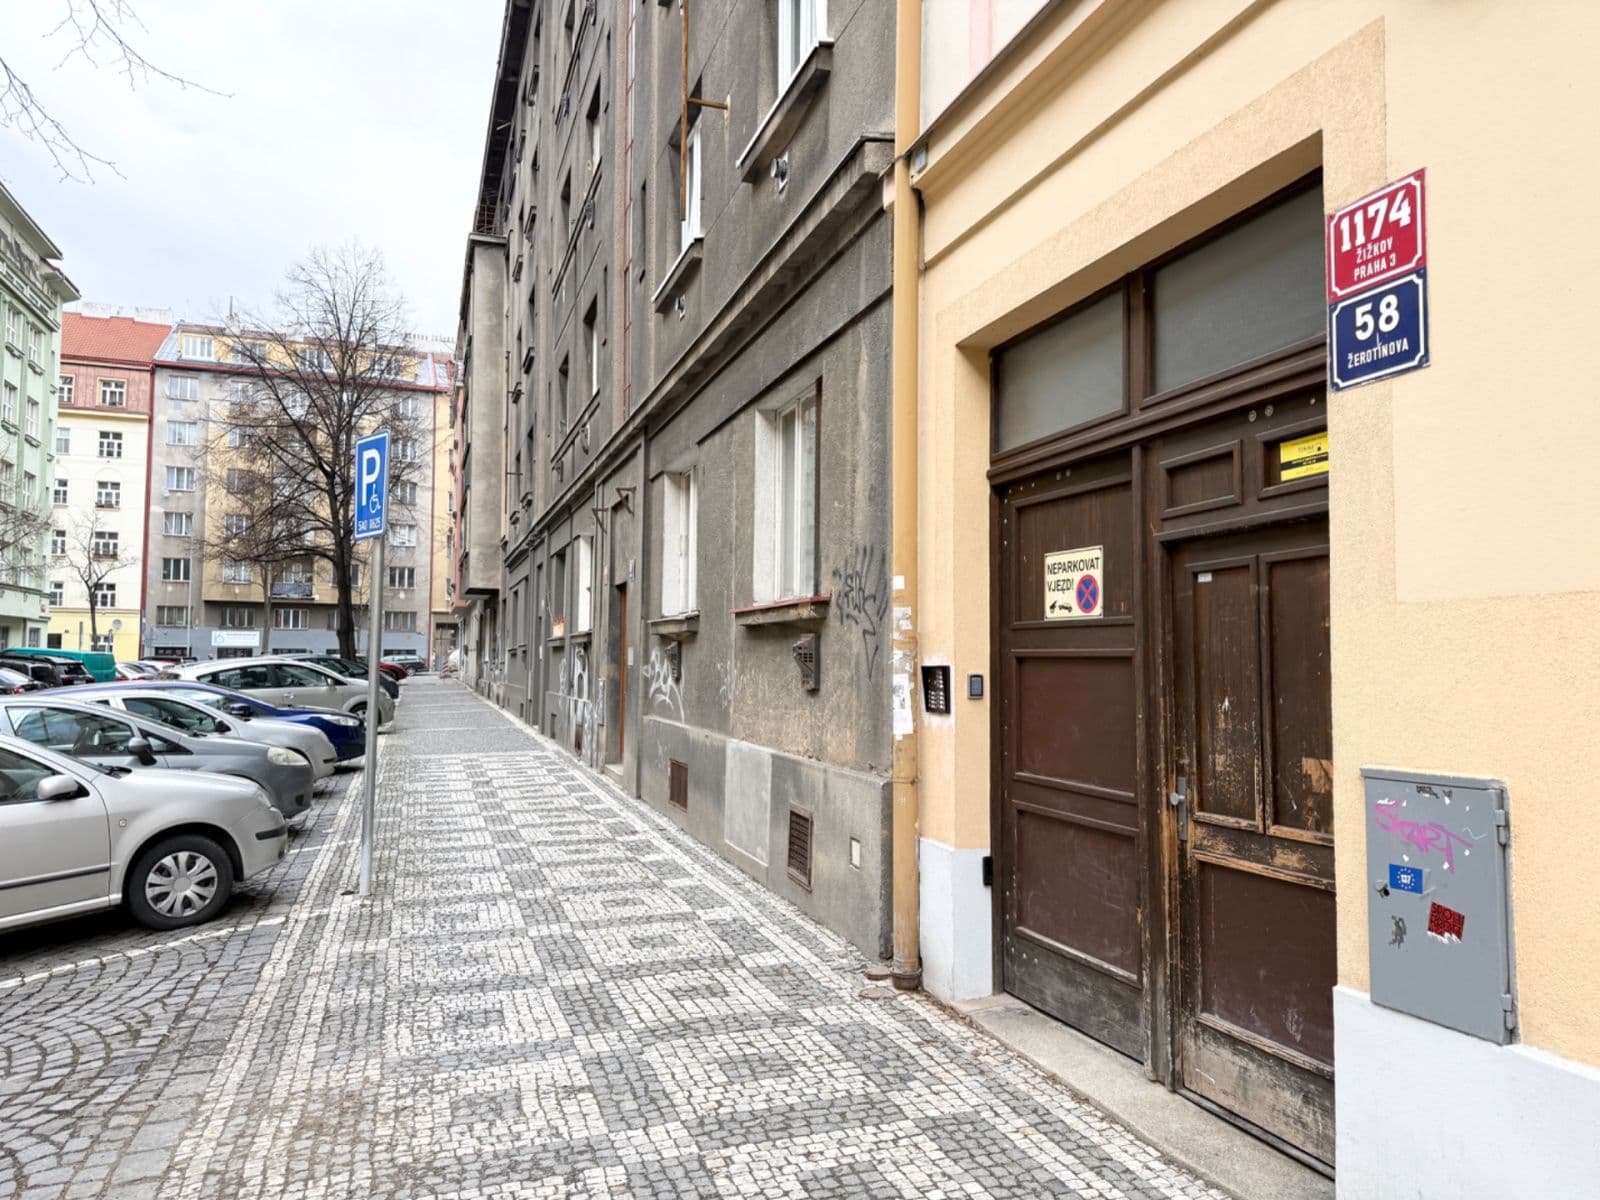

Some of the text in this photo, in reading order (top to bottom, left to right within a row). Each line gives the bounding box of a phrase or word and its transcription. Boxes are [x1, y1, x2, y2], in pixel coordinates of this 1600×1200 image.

[1340, 189, 1411, 252] 1174
[1354, 253, 1396, 281] PRAHA 3
[1356, 237, 1393, 264] ŽIŽKOV
[1355, 294, 1400, 341] 58
[1347, 336, 1409, 369] ŽEROTÍNOVA
[361, 448, 381, 506] P
[1047, 557, 1100, 575] NEPARKOVAT
